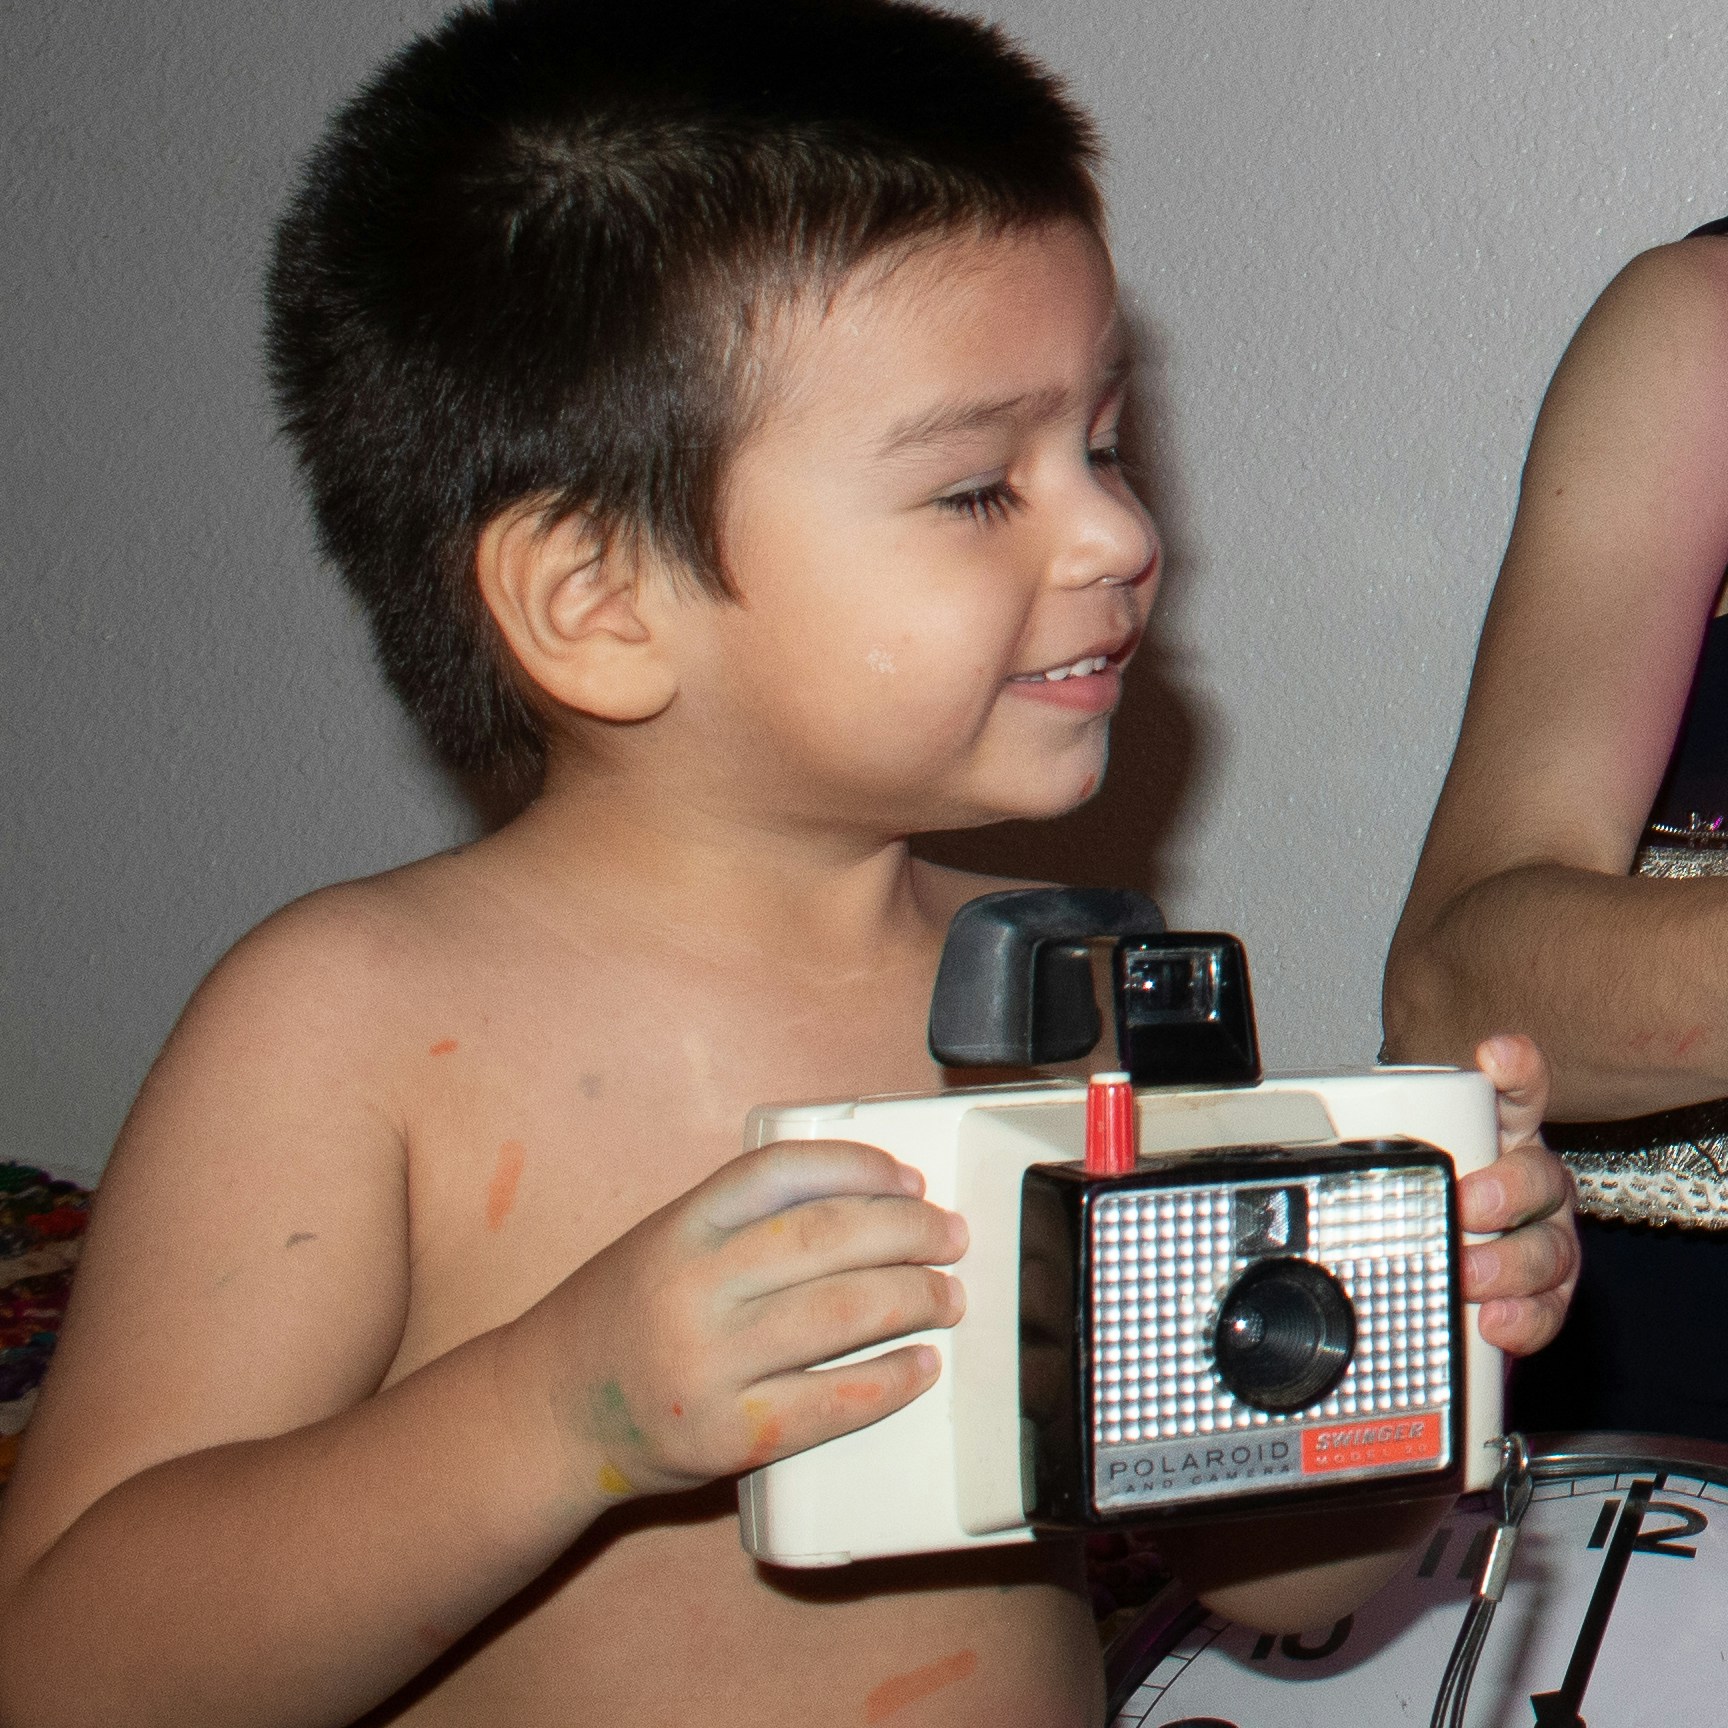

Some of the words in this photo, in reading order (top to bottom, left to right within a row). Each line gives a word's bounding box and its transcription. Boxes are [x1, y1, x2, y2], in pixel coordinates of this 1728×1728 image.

[1315, 1421, 1425, 1451] SWINGER
[1109, 1440, 1289, 1481] POLAROID
[1112, 1479, 1173, 1495] AND
[1191, 1464, 1290, 1486] CAMERA
[1587, 1499, 1709, 1559] 12
